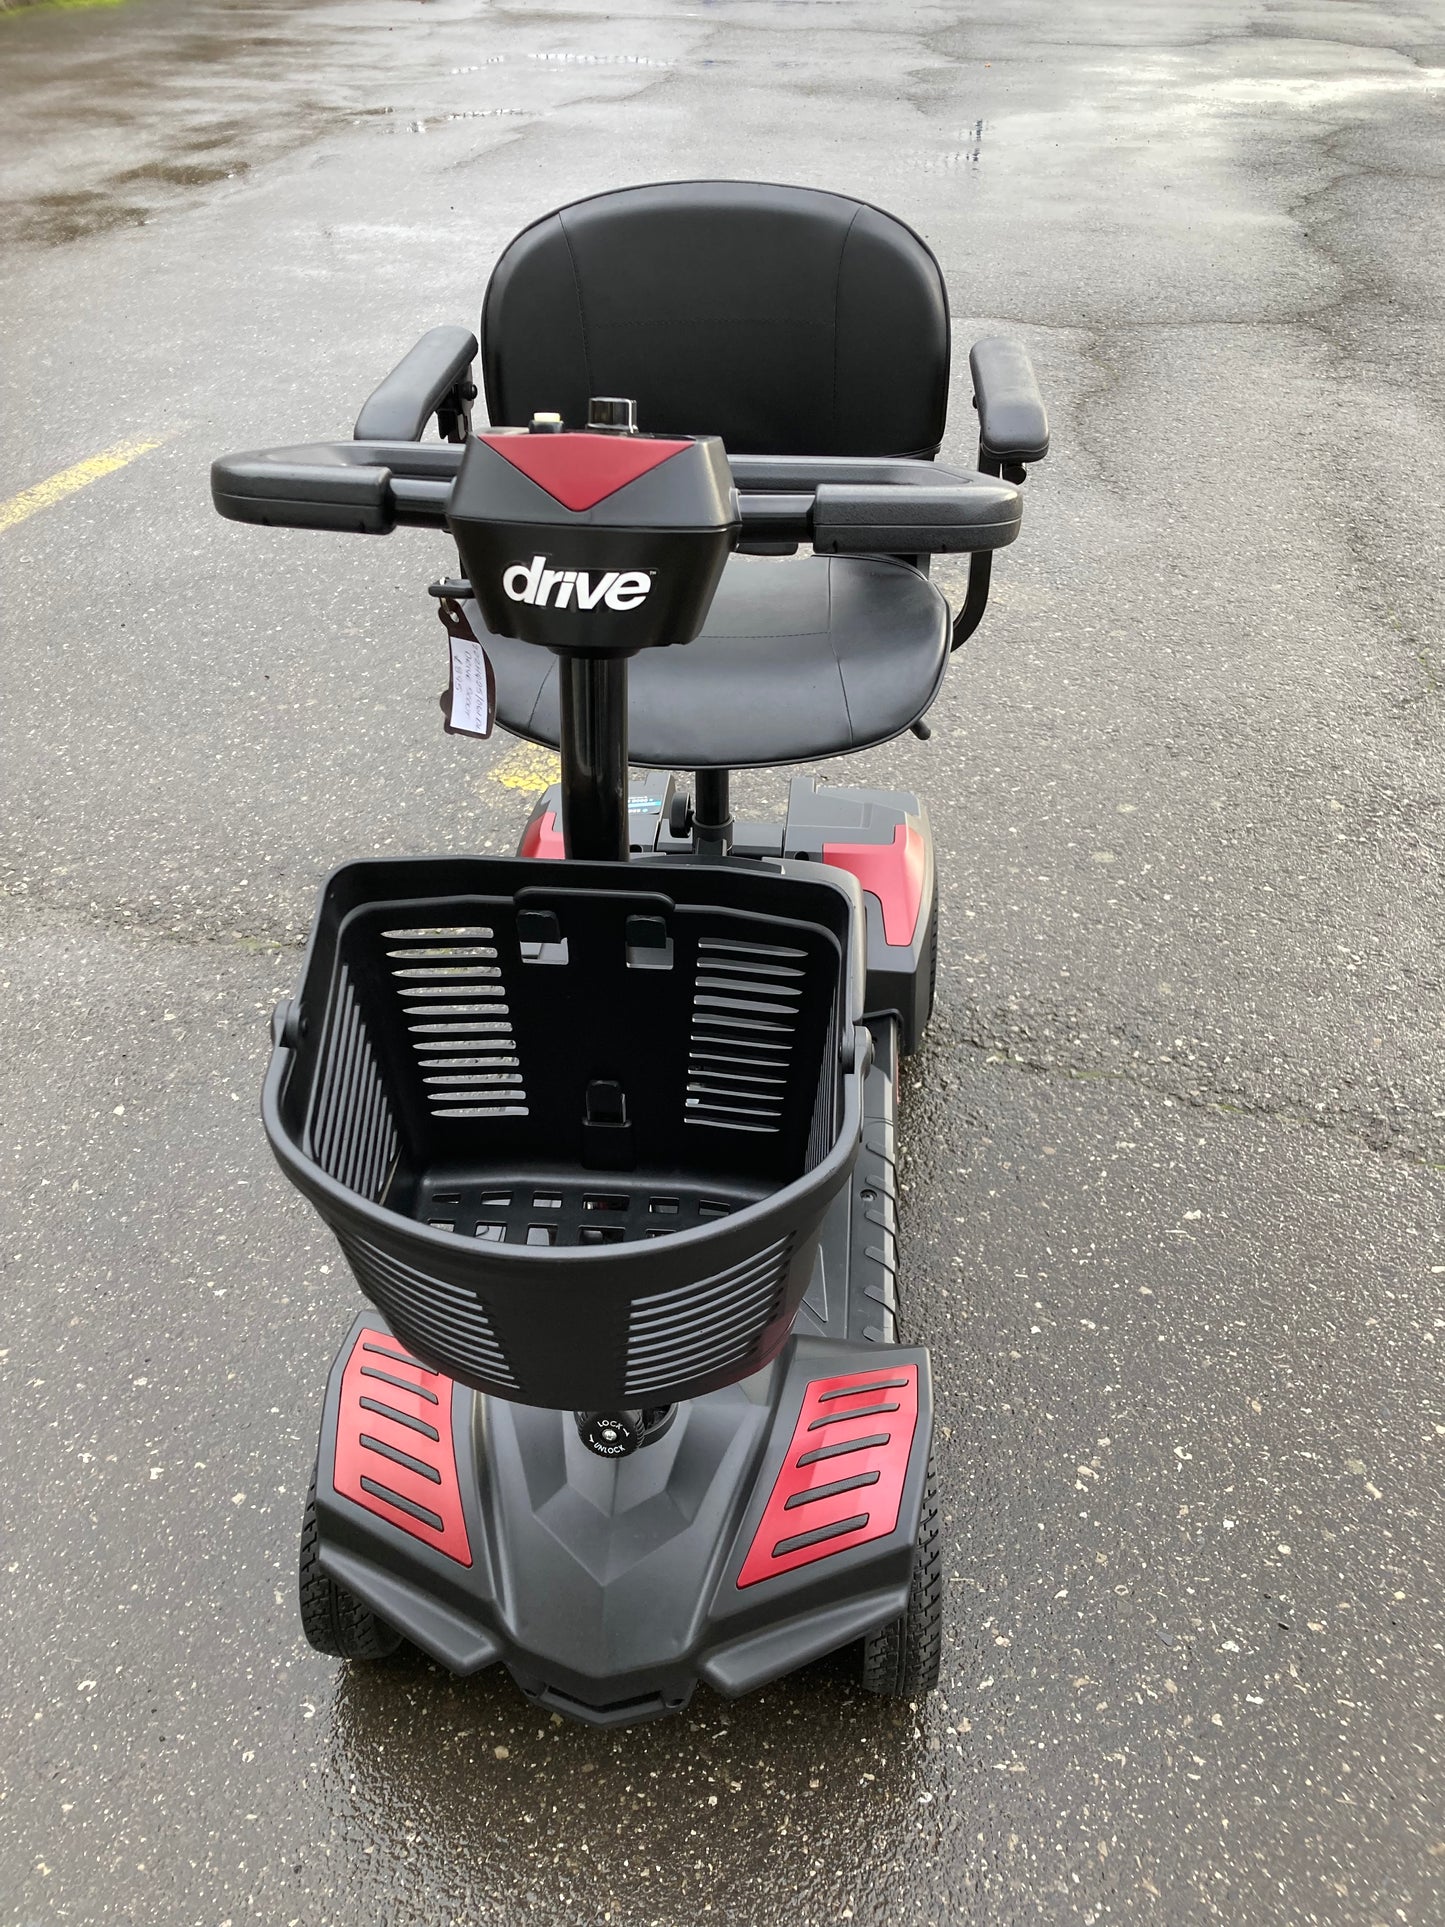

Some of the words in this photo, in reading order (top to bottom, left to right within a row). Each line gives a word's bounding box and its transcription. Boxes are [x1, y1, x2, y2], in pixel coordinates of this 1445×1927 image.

[503, 556, 651, 611] drive
[597, 1419, 623, 1430] LOCK
[593, 1442, 626, 1454] UNLOCK
